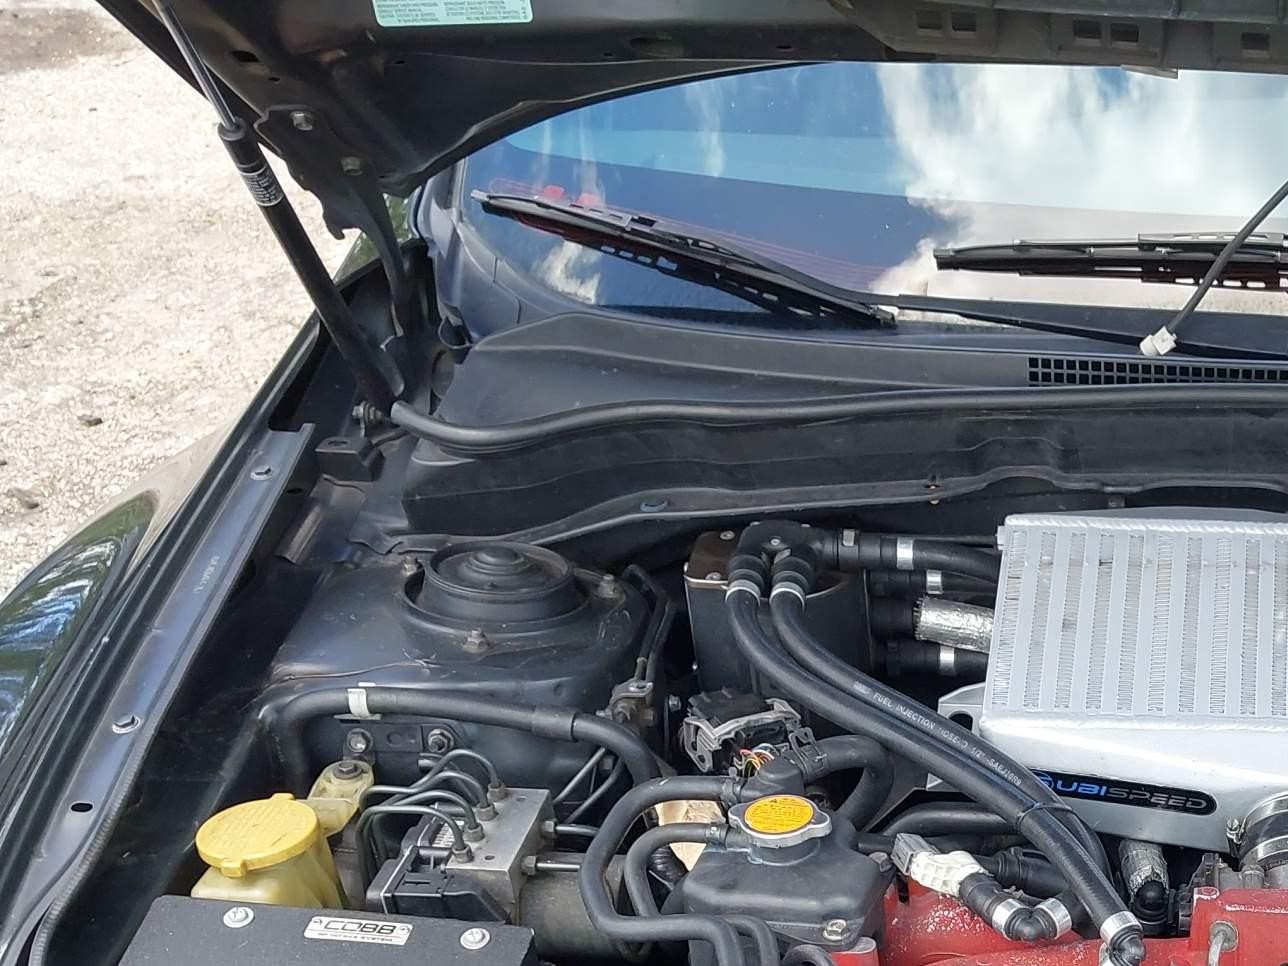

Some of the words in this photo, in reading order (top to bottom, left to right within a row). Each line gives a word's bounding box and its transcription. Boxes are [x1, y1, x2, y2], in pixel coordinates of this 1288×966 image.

[873, 692, 893, 708] FUEL
[896, 703, 936, 730] INJECTION
[324, 920, 397, 934] COBB
